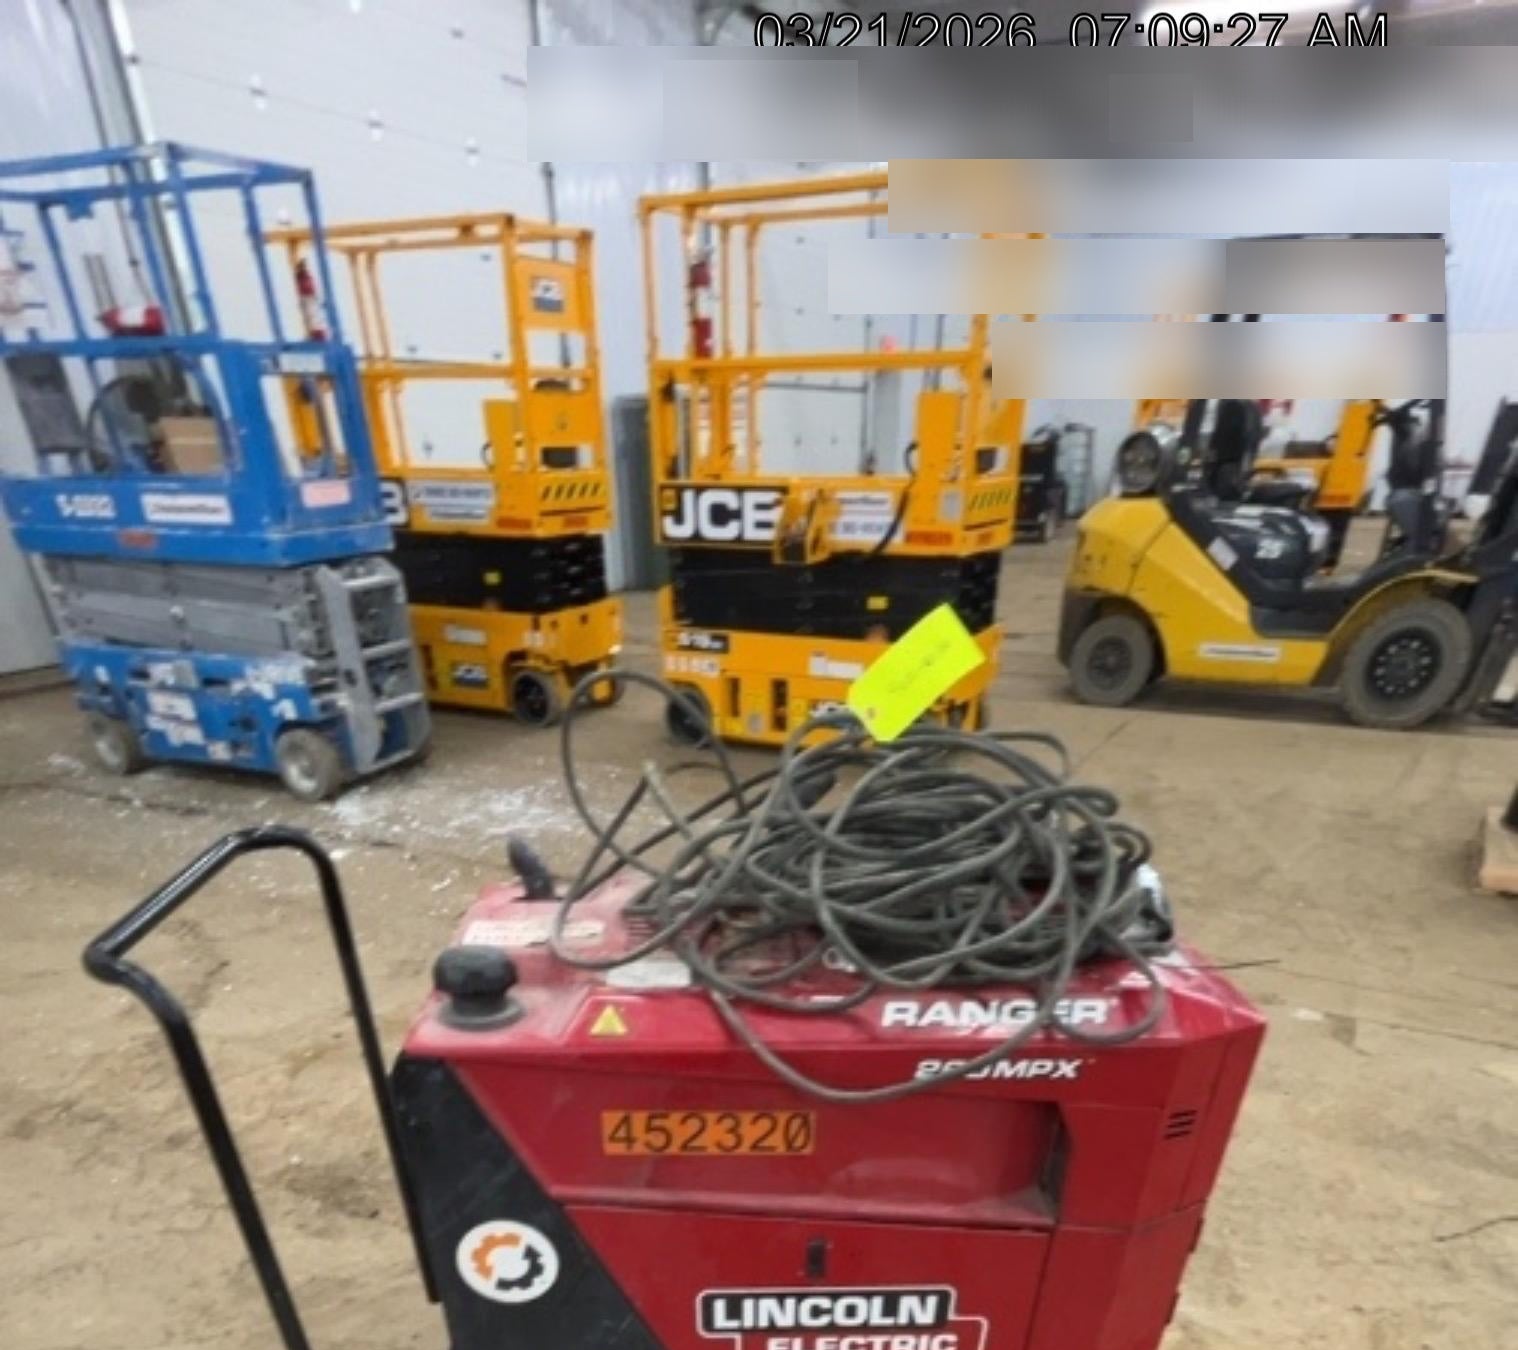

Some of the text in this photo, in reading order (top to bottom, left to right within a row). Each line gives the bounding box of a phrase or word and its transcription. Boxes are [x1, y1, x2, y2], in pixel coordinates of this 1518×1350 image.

[881, 998, 1111, 1028] RANGER
[607, 1112, 812, 1152] 452320
[712, 1295, 938, 1330] LINCOLN
